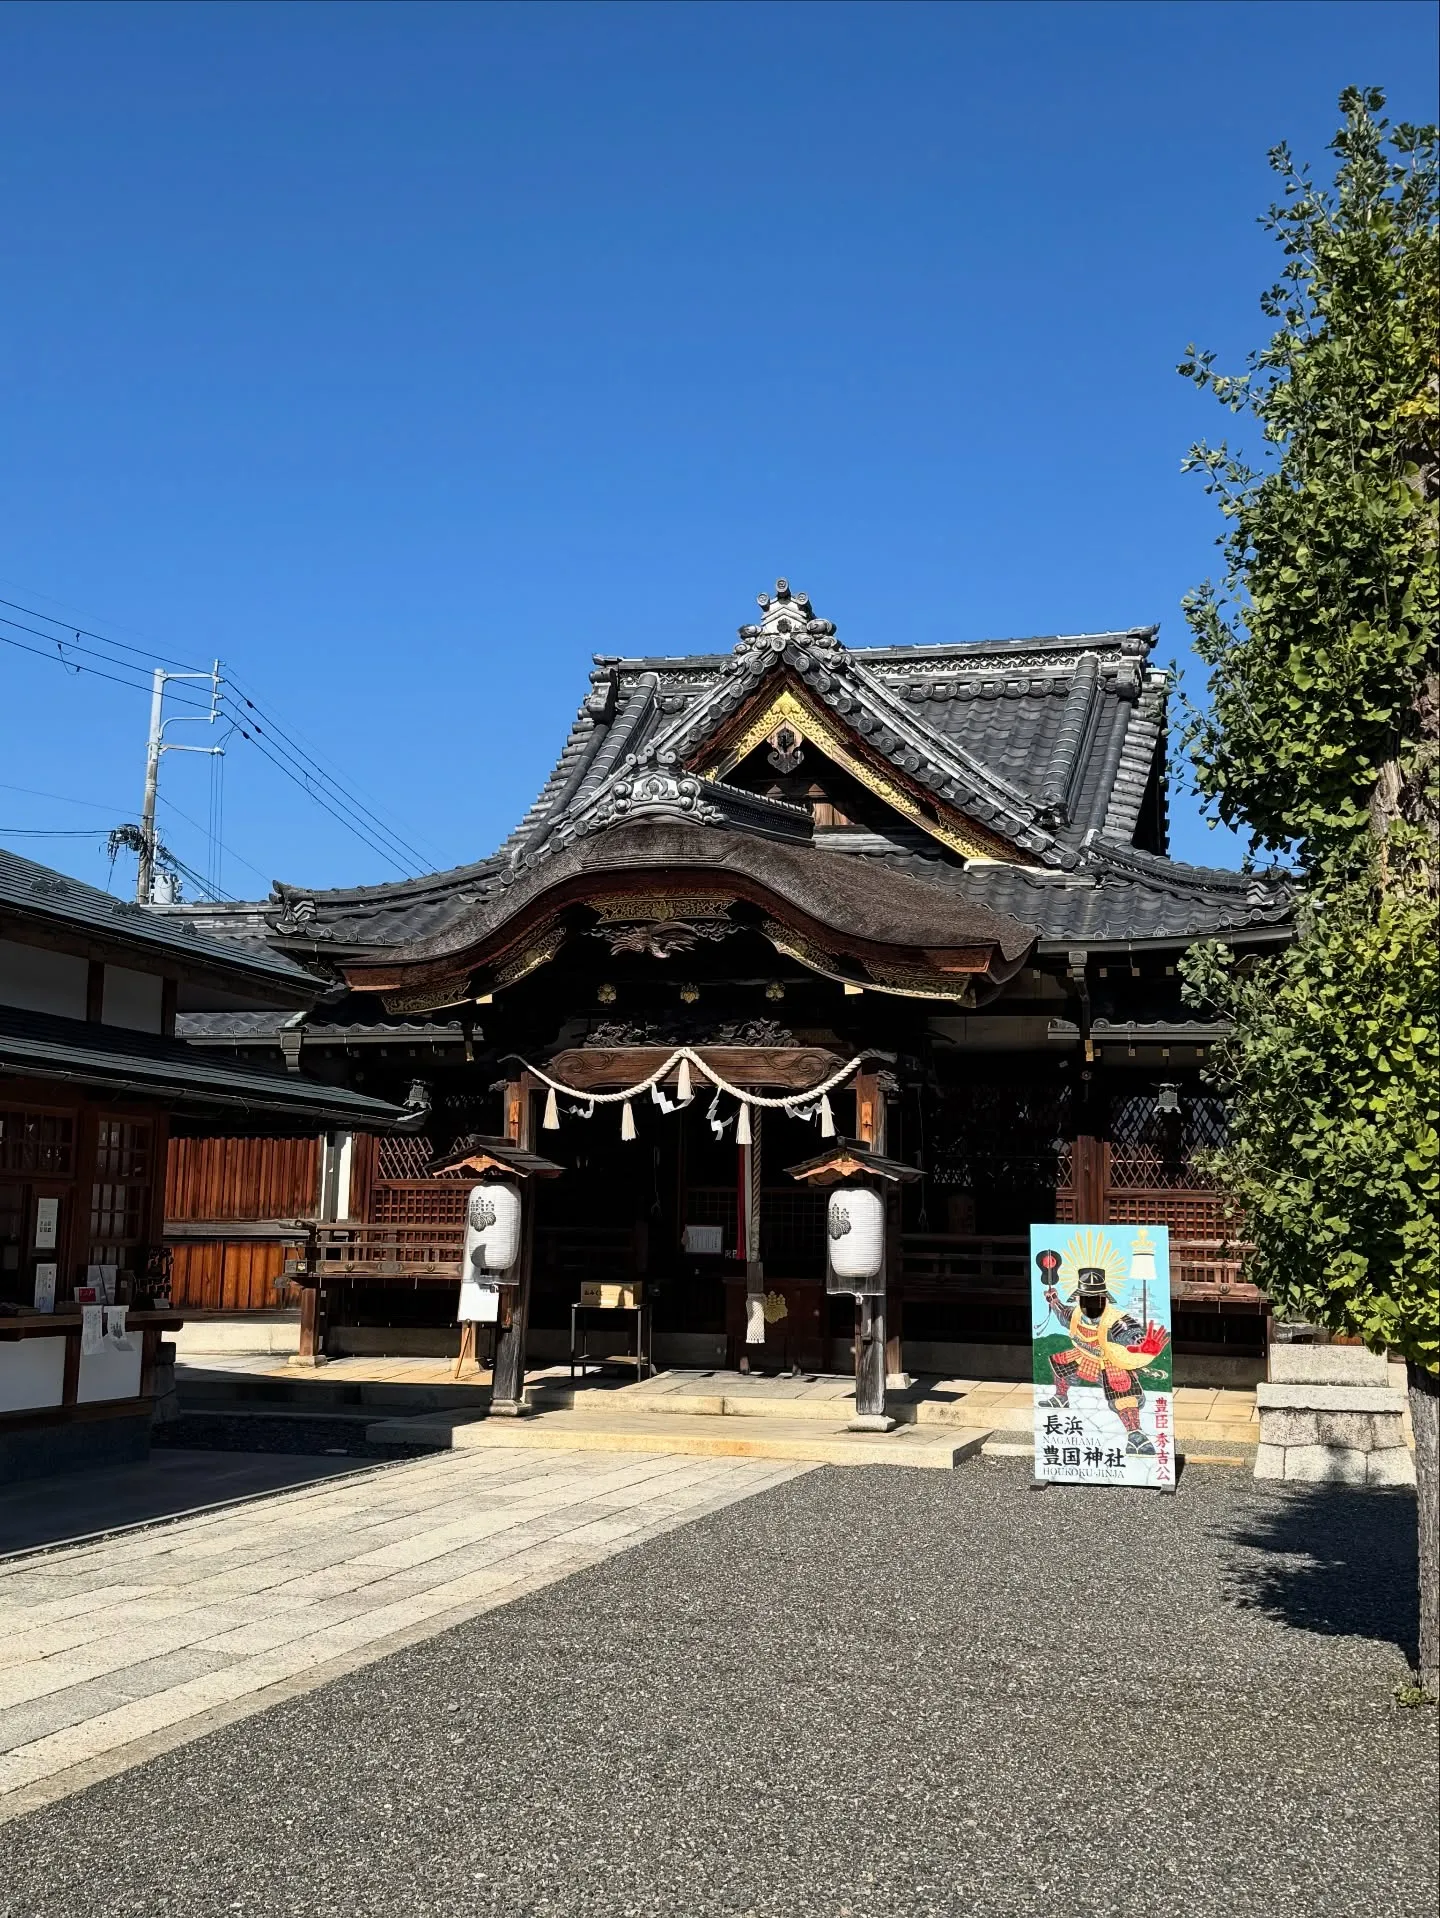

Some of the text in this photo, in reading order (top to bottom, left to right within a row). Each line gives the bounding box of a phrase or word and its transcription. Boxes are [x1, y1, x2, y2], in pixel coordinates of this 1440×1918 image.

[1042, 1414, 1083, 1436] 長浜
[1042, 1435, 1102, 1447] NAGAHAMA
[1043, 1445, 1126, 1468] 豊国神社
